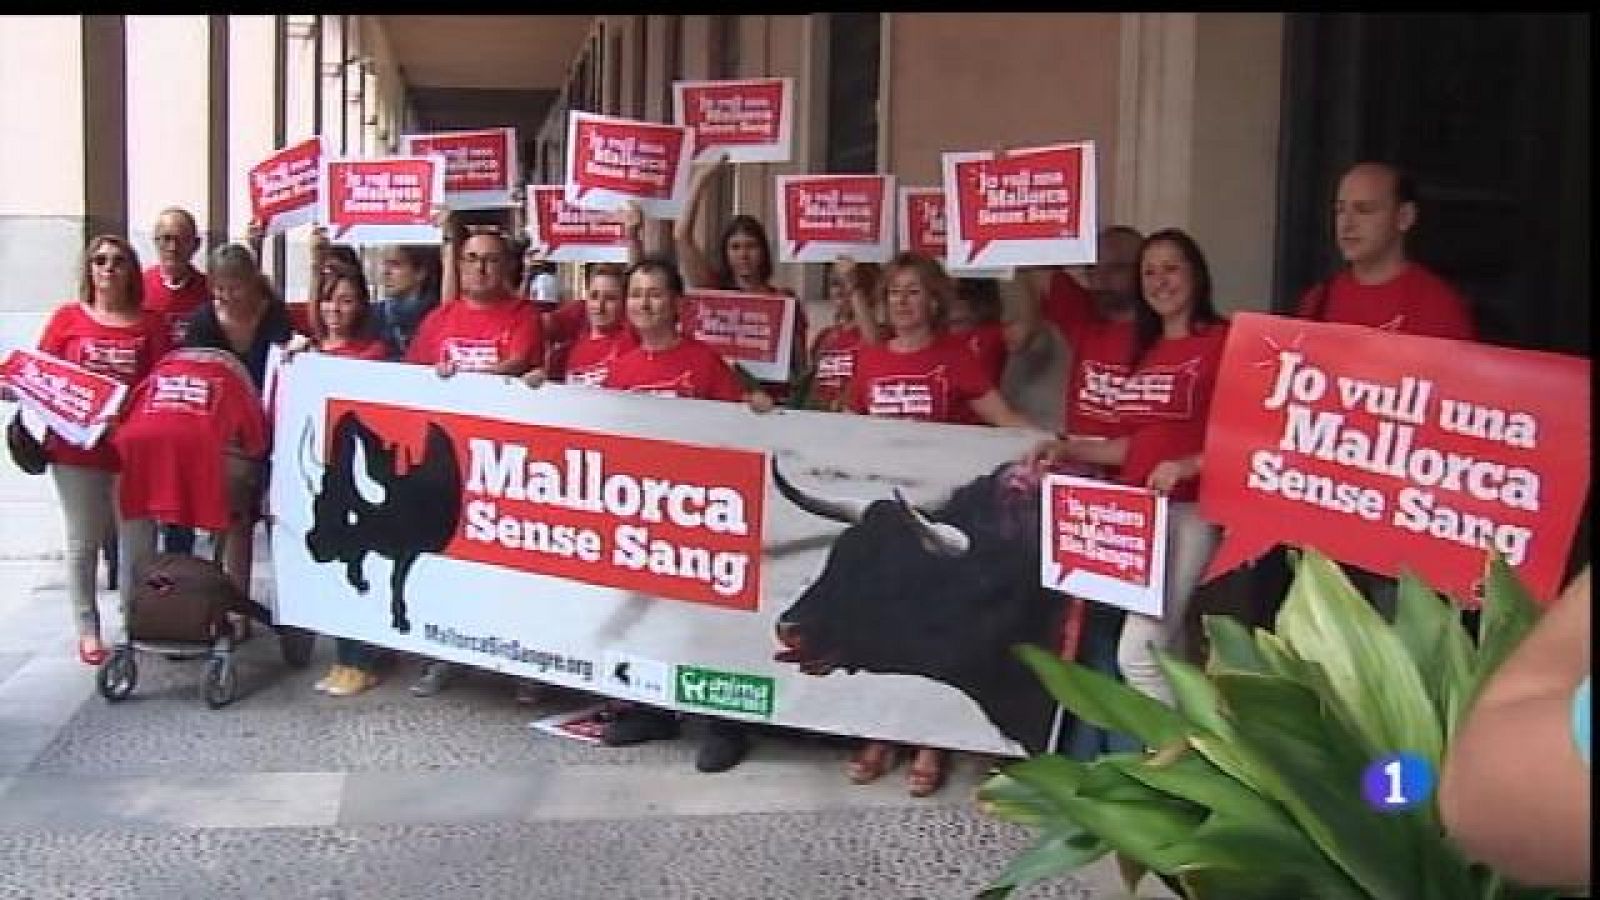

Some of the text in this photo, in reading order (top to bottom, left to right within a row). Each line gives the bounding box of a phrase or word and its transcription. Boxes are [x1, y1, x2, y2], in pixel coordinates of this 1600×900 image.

[986, 188, 1069, 208] Mallorca
[1264, 350, 1537, 448] Jo vull una
[466, 438, 748, 536] Mallorca
[1279, 404, 1541, 511] Mallorca
[464, 499, 748, 597] Sense Sang
[1247, 450, 1532, 566] Sense Sang
